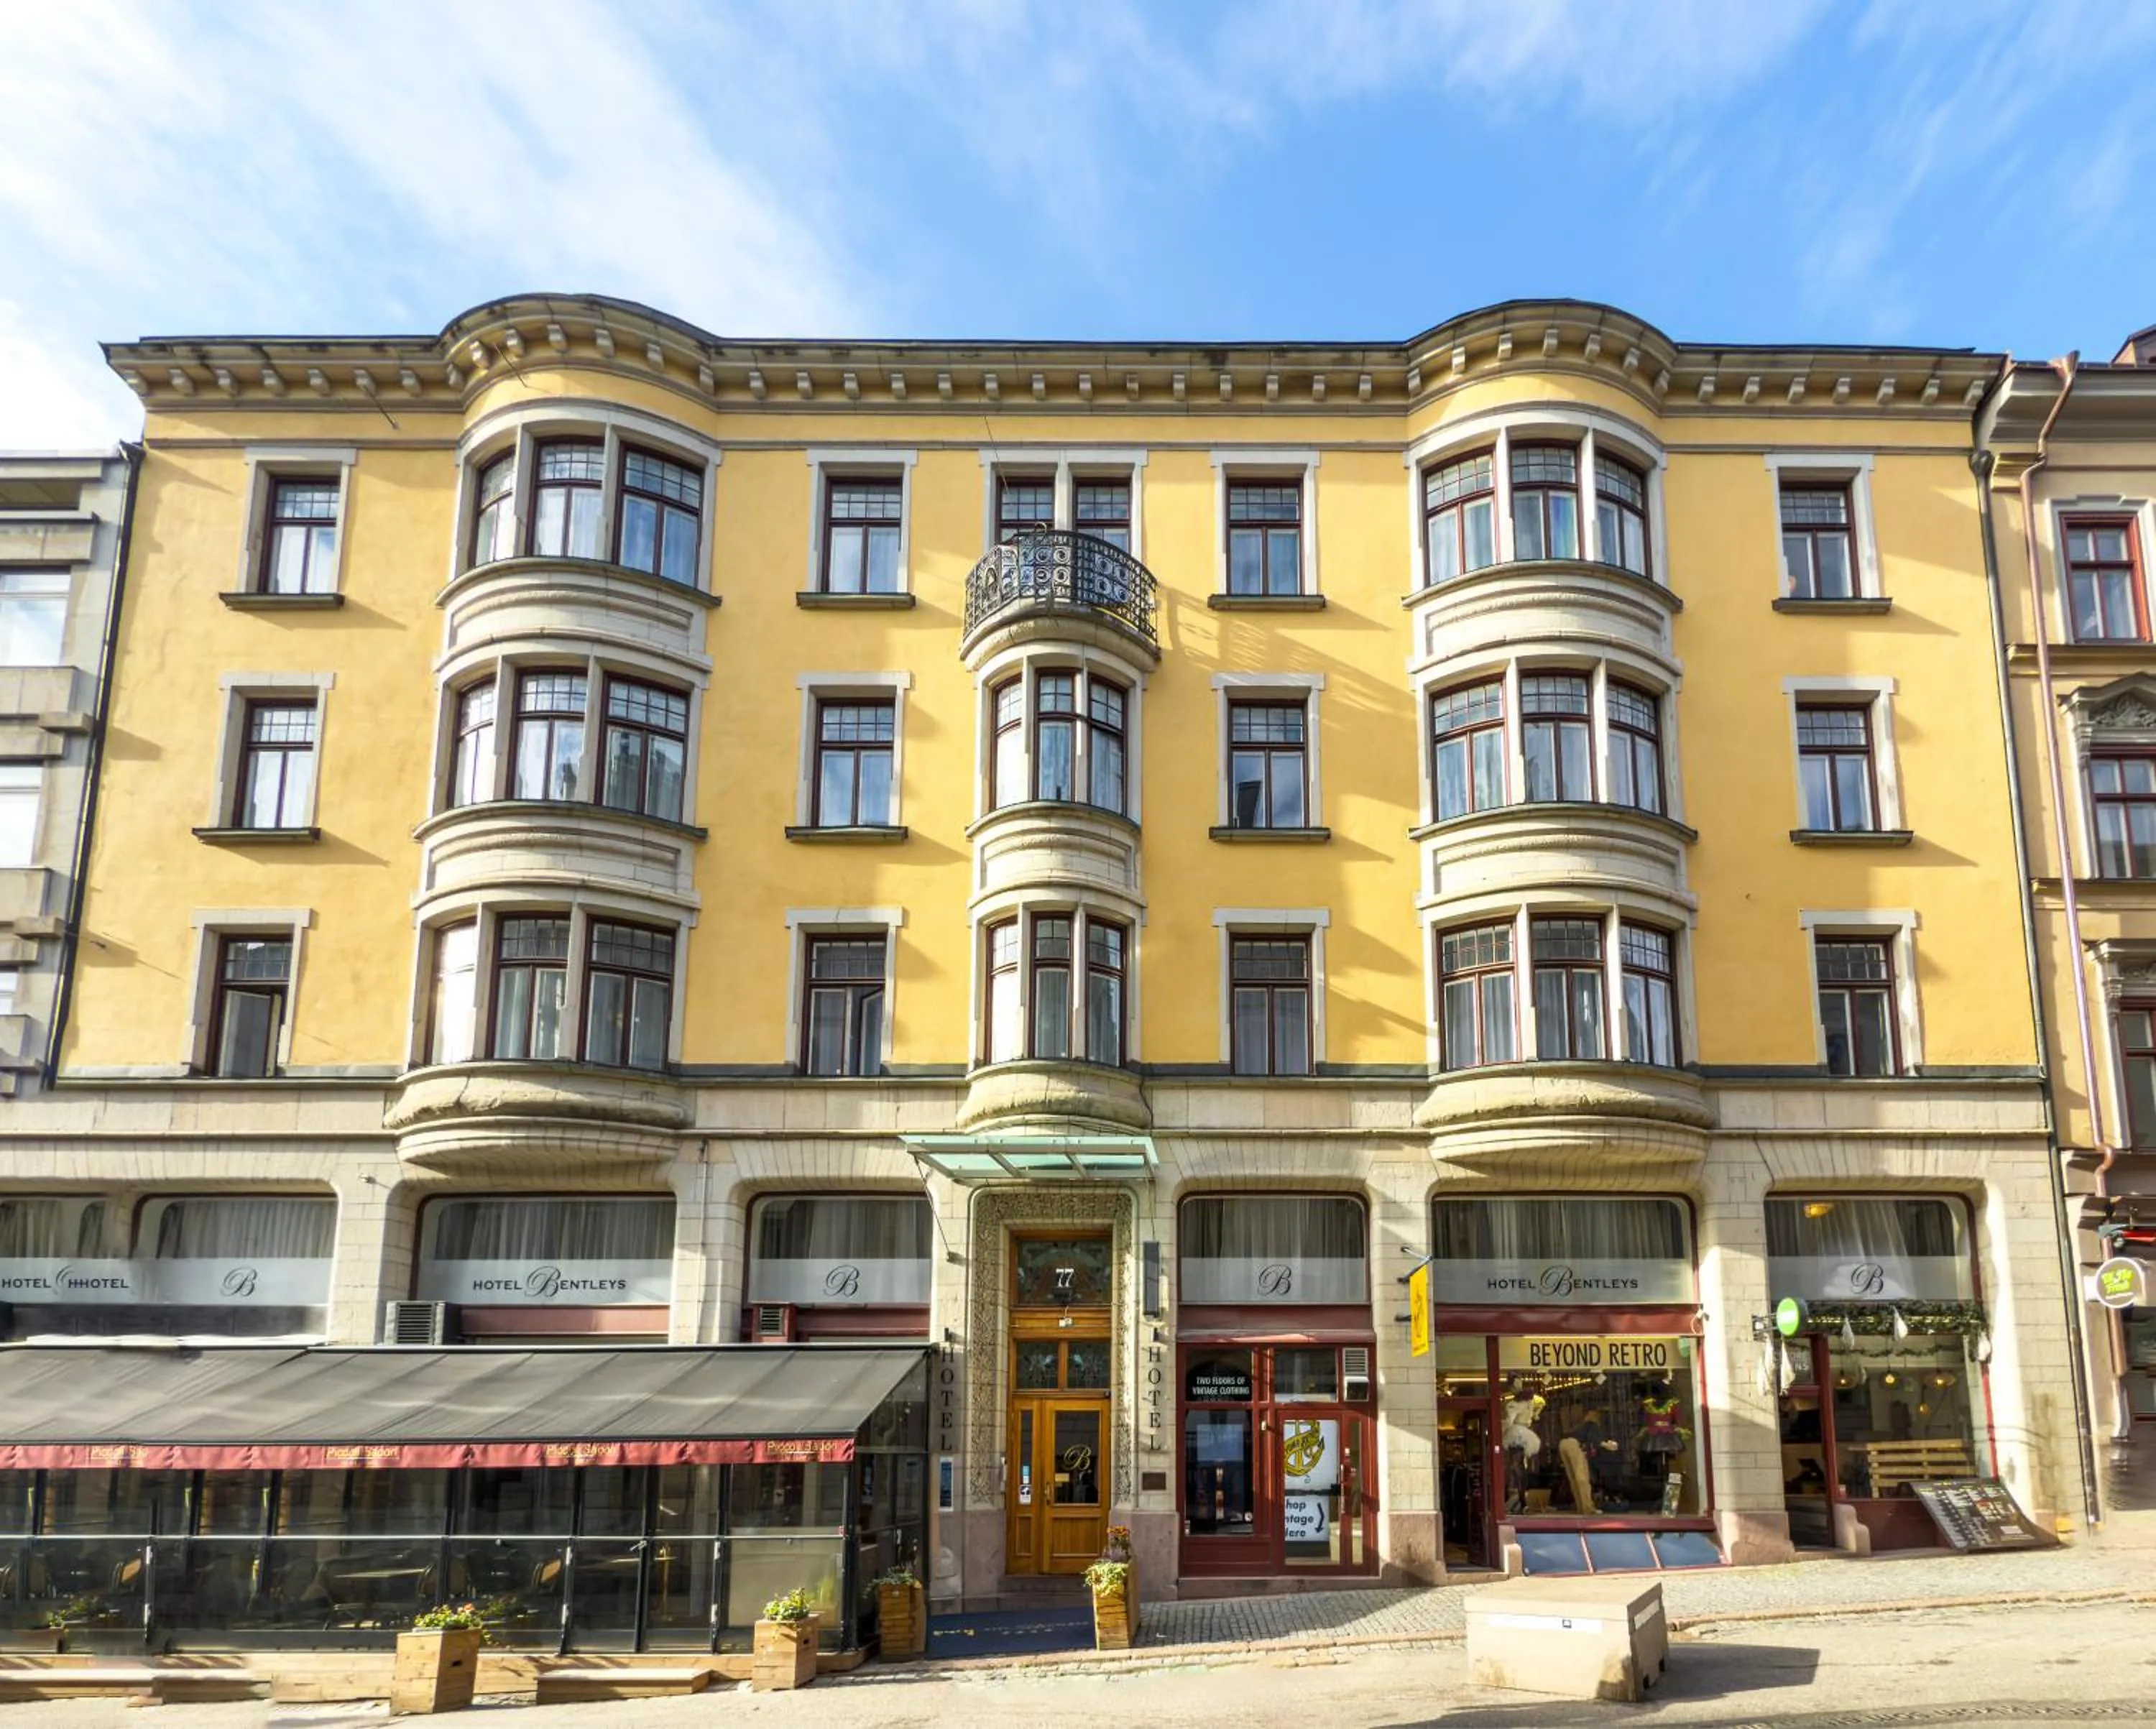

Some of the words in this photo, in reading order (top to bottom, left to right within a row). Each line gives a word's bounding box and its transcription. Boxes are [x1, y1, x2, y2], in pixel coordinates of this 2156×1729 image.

[1, 1278, 52, 1288] HOTEL
[473, 1280, 522, 1291] HOTEL
[525, 1265, 627, 1297] BENTLEYS
[823, 1265, 860, 1297] B
[1056, 1268, 1074, 1288] 77
[1257, 1265, 1291, 1296] B
[1487, 1278, 1536, 1289] HOTEL
[1539, 1265, 1639, 1296] BENTLEYS
[1851, 1263, 1884, 1294] B
[1530, 1343, 1601, 1367] BEYOND
[1609, 1342, 1667, 1367] RETRO
[1192, 1386, 1217, 1395] VINTAGE
[1220, 1386, 1250, 1395] CLOTHING
[1196, 1376, 1210, 1385] TWO
[1212, 1376, 1235, 1385] FLOORS
[1237, 1376, 1245, 1385] OF
[941, 1347, 954, 1451] HOTEL
[1148, 1347, 1161, 1450] HOTEL
[1286, 1499, 1306, 1512] hop
[1286, 1529, 1306, 1537] ere
